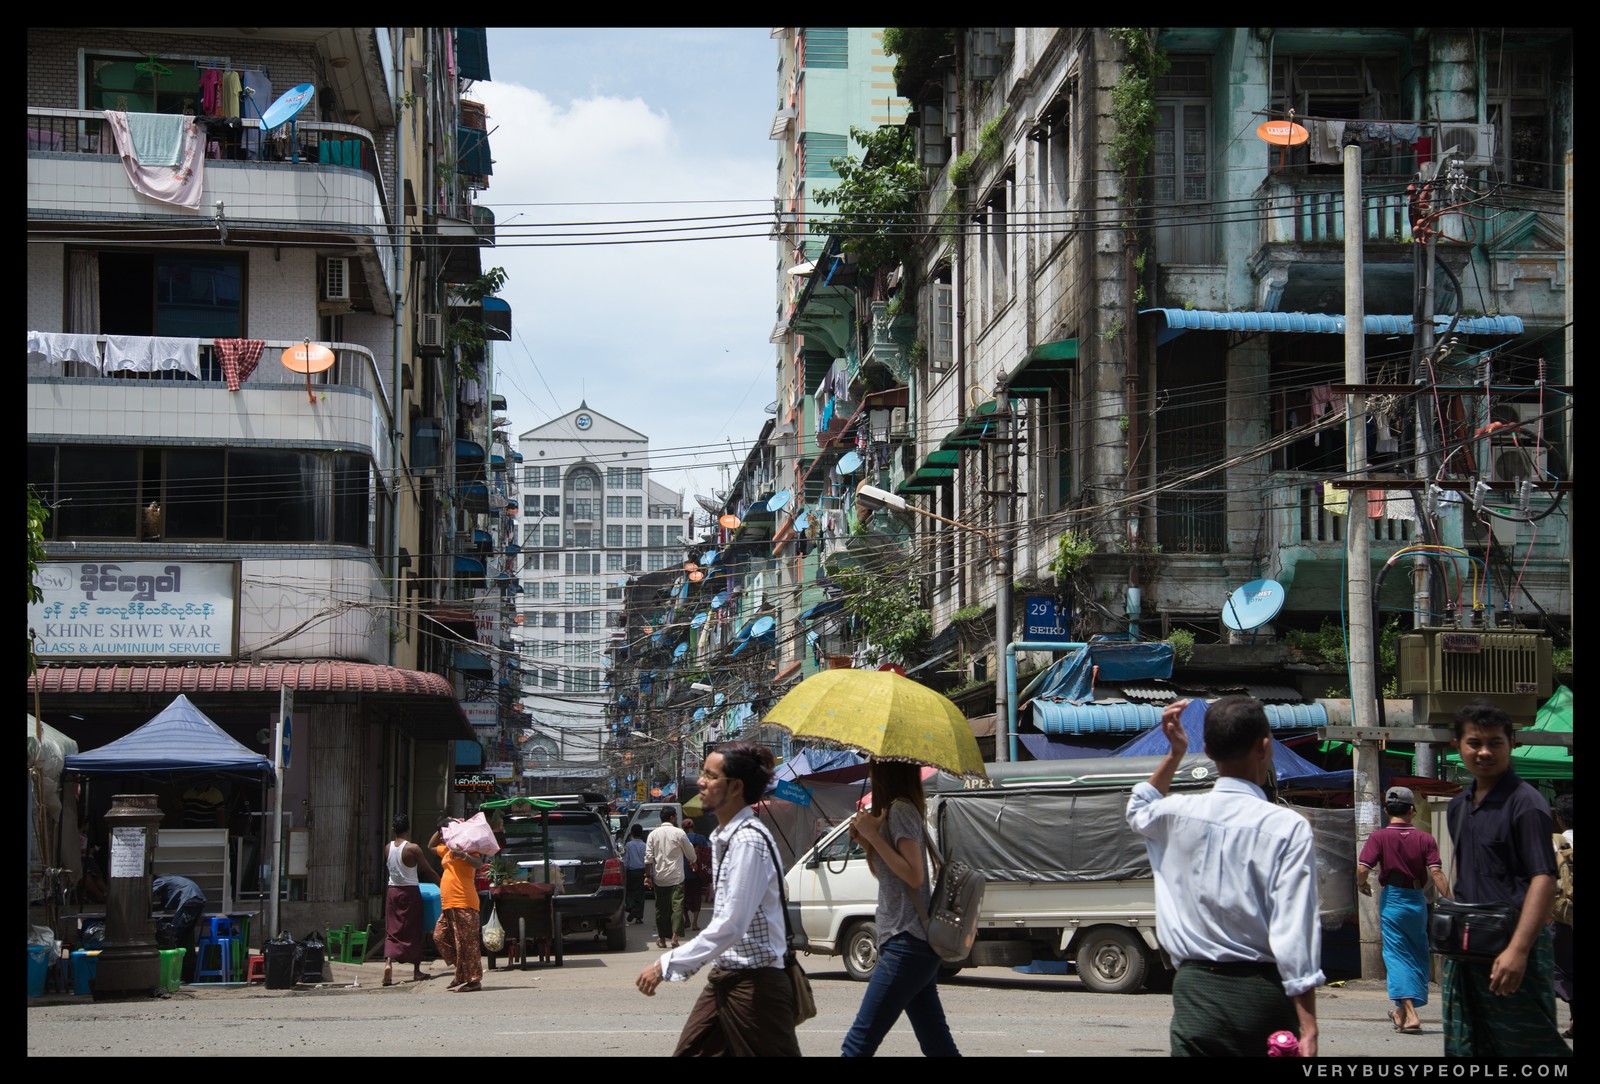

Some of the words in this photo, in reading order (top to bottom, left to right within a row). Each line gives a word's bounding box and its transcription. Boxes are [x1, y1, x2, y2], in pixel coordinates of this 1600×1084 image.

[45, 623, 104, 638] KHINE
[110, 624, 163, 638] SHWE
[169, 624, 212, 638] WAR
[1029, 626, 1065, 636] SEIKO
[1445, 635, 1477, 645] YANGON
[35, 642, 75, 654] GLASS
[79, 643, 88, 654] &
[92, 643, 165, 654] ALUMINIUM
[169, 643, 220, 654] SERVICE
[963, 779, 994, 789] APEX
